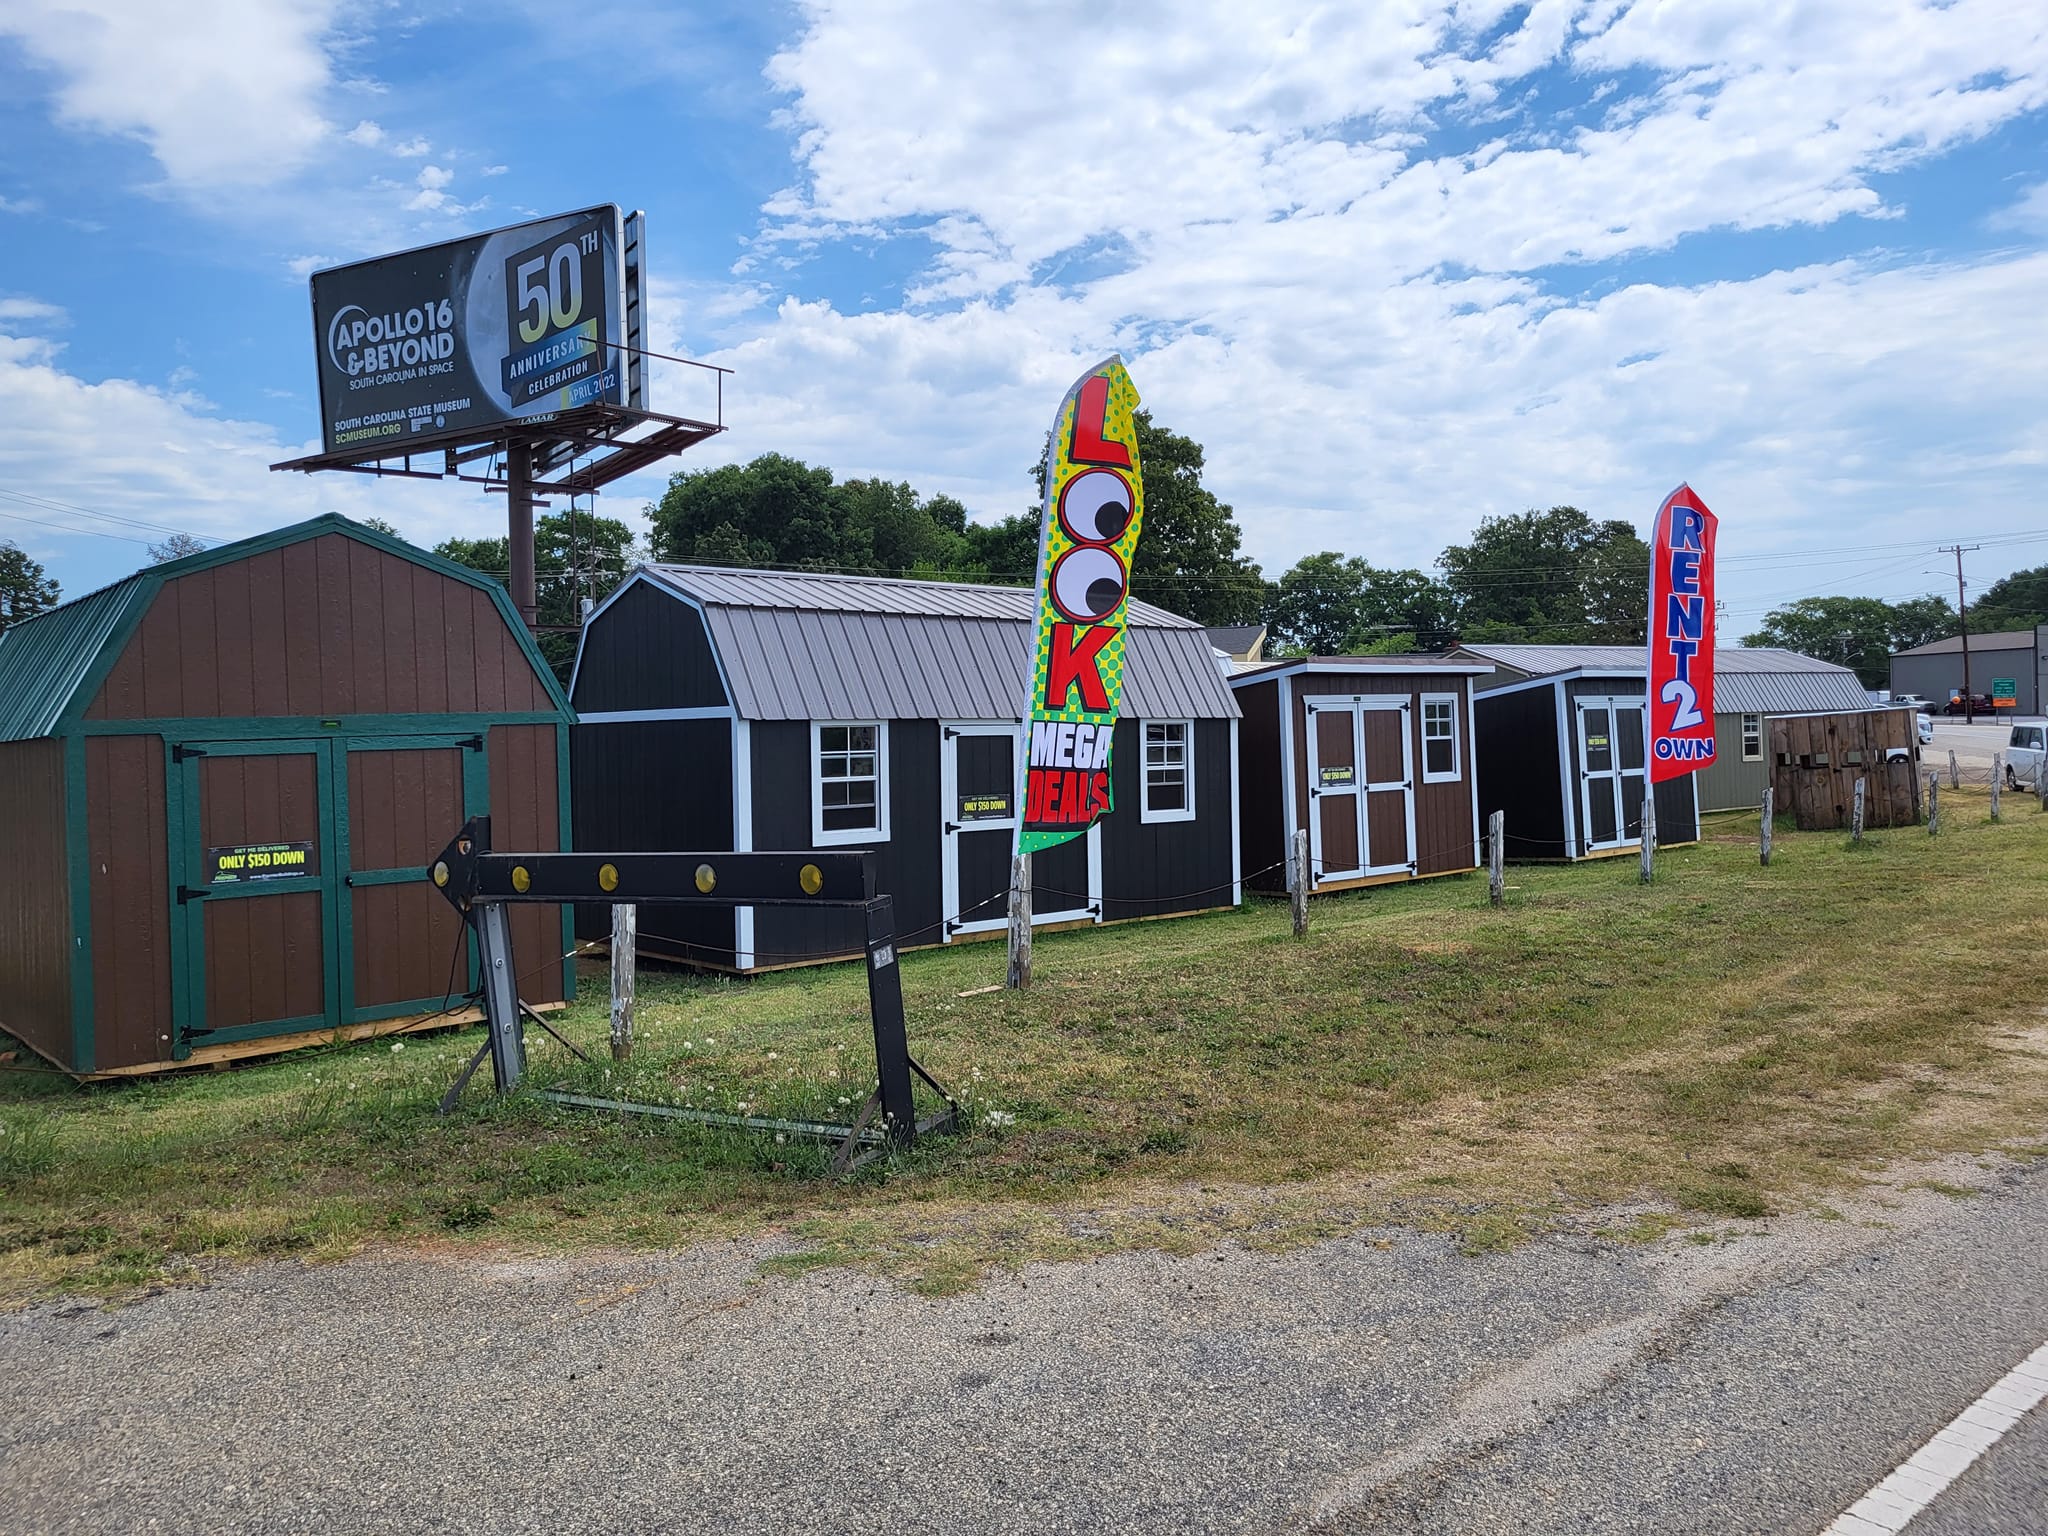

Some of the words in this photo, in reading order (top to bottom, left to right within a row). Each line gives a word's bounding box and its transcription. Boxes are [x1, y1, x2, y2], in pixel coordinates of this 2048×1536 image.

[337, 308, 424, 350] APOLLO
[424, 299, 453, 331] 16
[510, 331, 591, 379] ANNIVERSARY
[349, 376, 375, 390] SOUTH
[375, 369, 417, 385] CAROLINA
[418, 366, 425, 377] IN
[428, 361, 455, 375] SPACE
[528, 360, 588, 395] CELEBRATION
[568, 383, 593, 403] APRIL
[334, 417, 362, 432] SOUTH
[362, 409, 406, 426] CAROLINA
[407, 404, 432, 418] STATE
[433, 398, 471, 414] MUSEUM
[521, 412, 557, 425] LAMAR
[335, 423, 401, 444] SCMUSEUM.ORG
[1666, 505, 1706, 683] RENT
[1660, 679, 1705, 732] 2
[1030, 721, 1113, 769] MEGA
[1655, 737, 1715, 761] OWN
[1025, 770, 1110, 823] DEALS
[219, 854, 246, 870] ONLY
[247, 852, 271, 869] $150
[273, 850, 305, 865] DOWN
